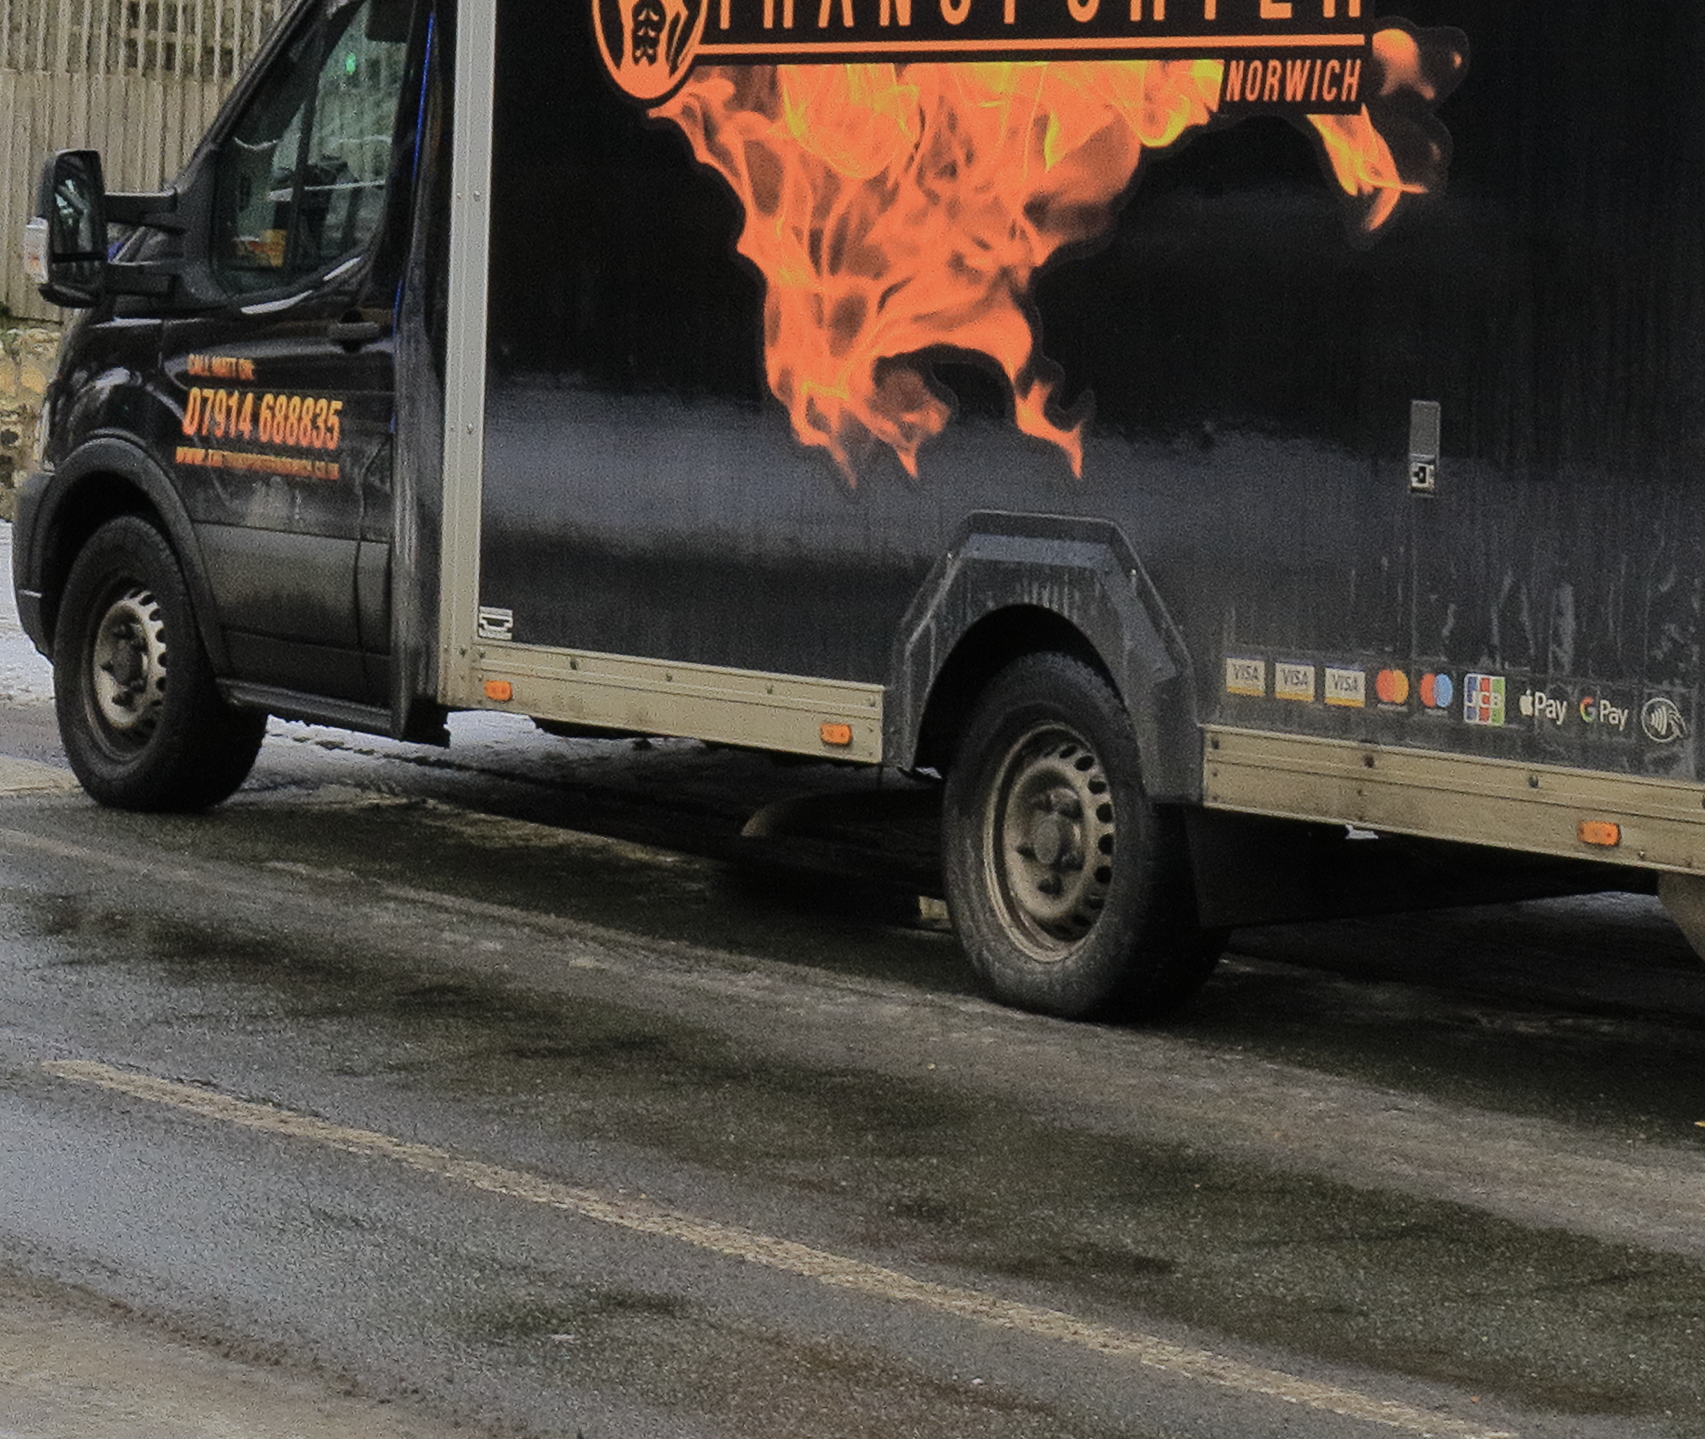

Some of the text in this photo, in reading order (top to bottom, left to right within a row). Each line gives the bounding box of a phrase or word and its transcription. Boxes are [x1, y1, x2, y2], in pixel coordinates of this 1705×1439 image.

[1226, 59, 1363, 104] NORWICH
[182, 387, 343, 450] 07914 688835
[1233, 664, 1259, 682] VISA
[1281, 669, 1308, 687] VISA
[1333, 674, 1359, 692] VISA
[1534, 692, 1567, 725] Pay
[1600, 699, 1628, 731] Pay
